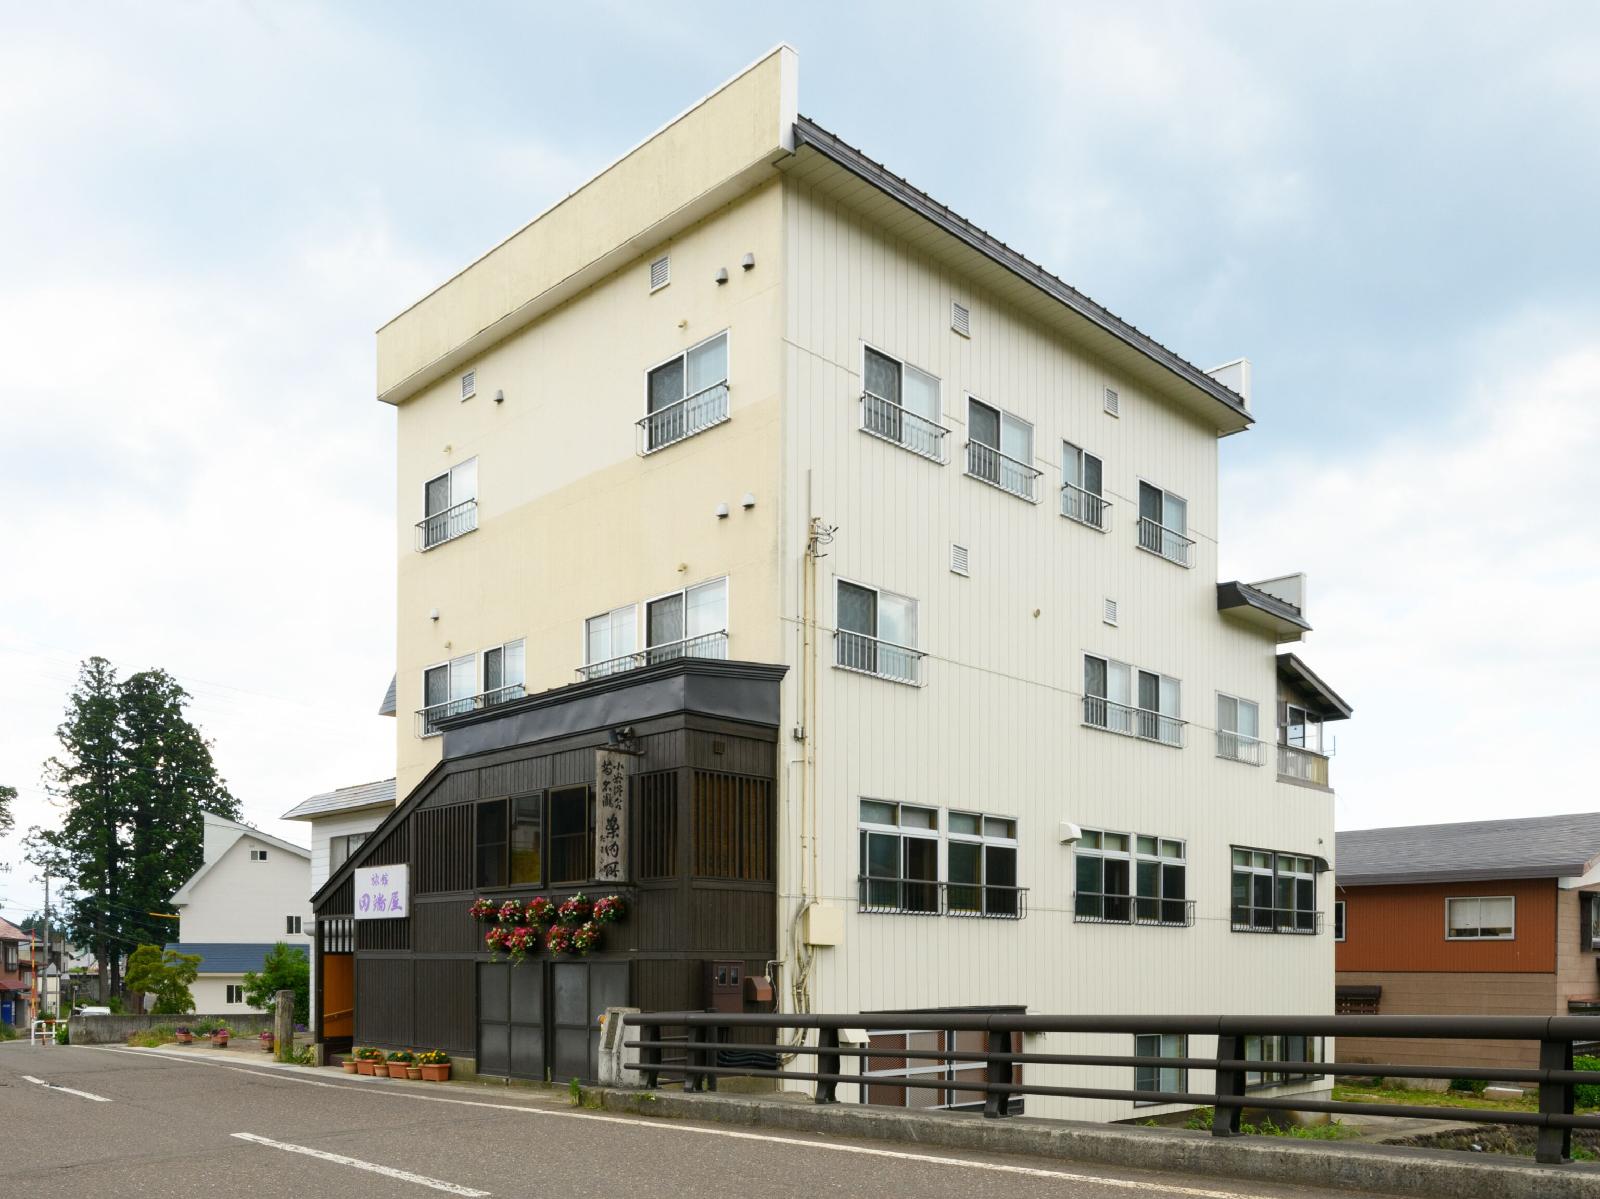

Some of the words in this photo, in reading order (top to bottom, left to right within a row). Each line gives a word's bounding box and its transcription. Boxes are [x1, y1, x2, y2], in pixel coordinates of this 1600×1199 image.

[603, 813, 620, 878] 案内所
[371, 872, 389, 886] 旅館
